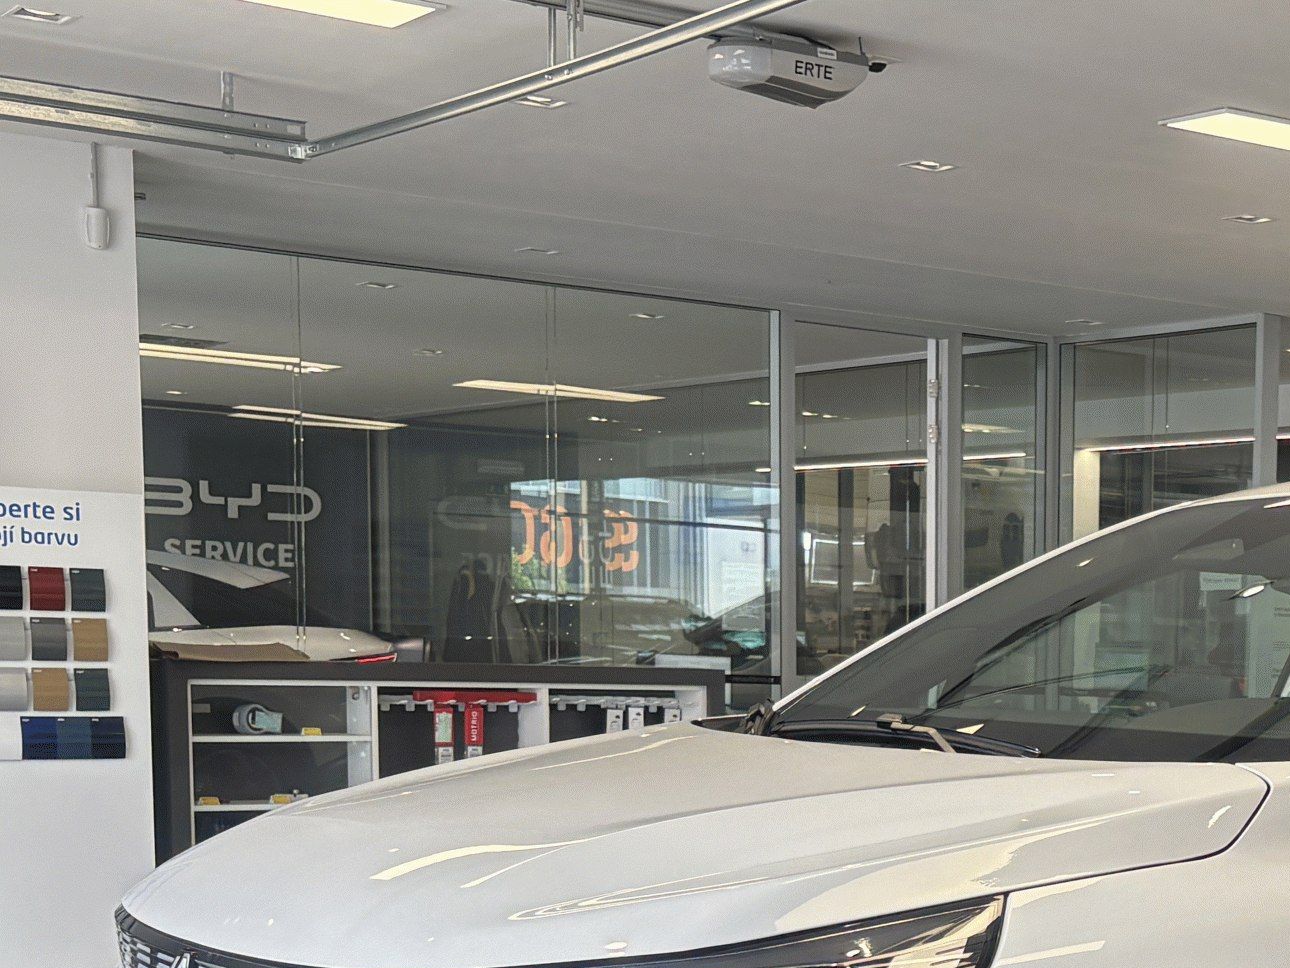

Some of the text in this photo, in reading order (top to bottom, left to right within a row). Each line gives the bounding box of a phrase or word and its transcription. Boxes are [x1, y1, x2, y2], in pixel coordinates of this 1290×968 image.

[795, 59, 835, 81] ERTE
[144, 476, 323, 523] BYD
[62, 501, 81, 521] si
[0, 525, 79, 547] jí barvu
[164, 538, 296, 568] SERVICE
